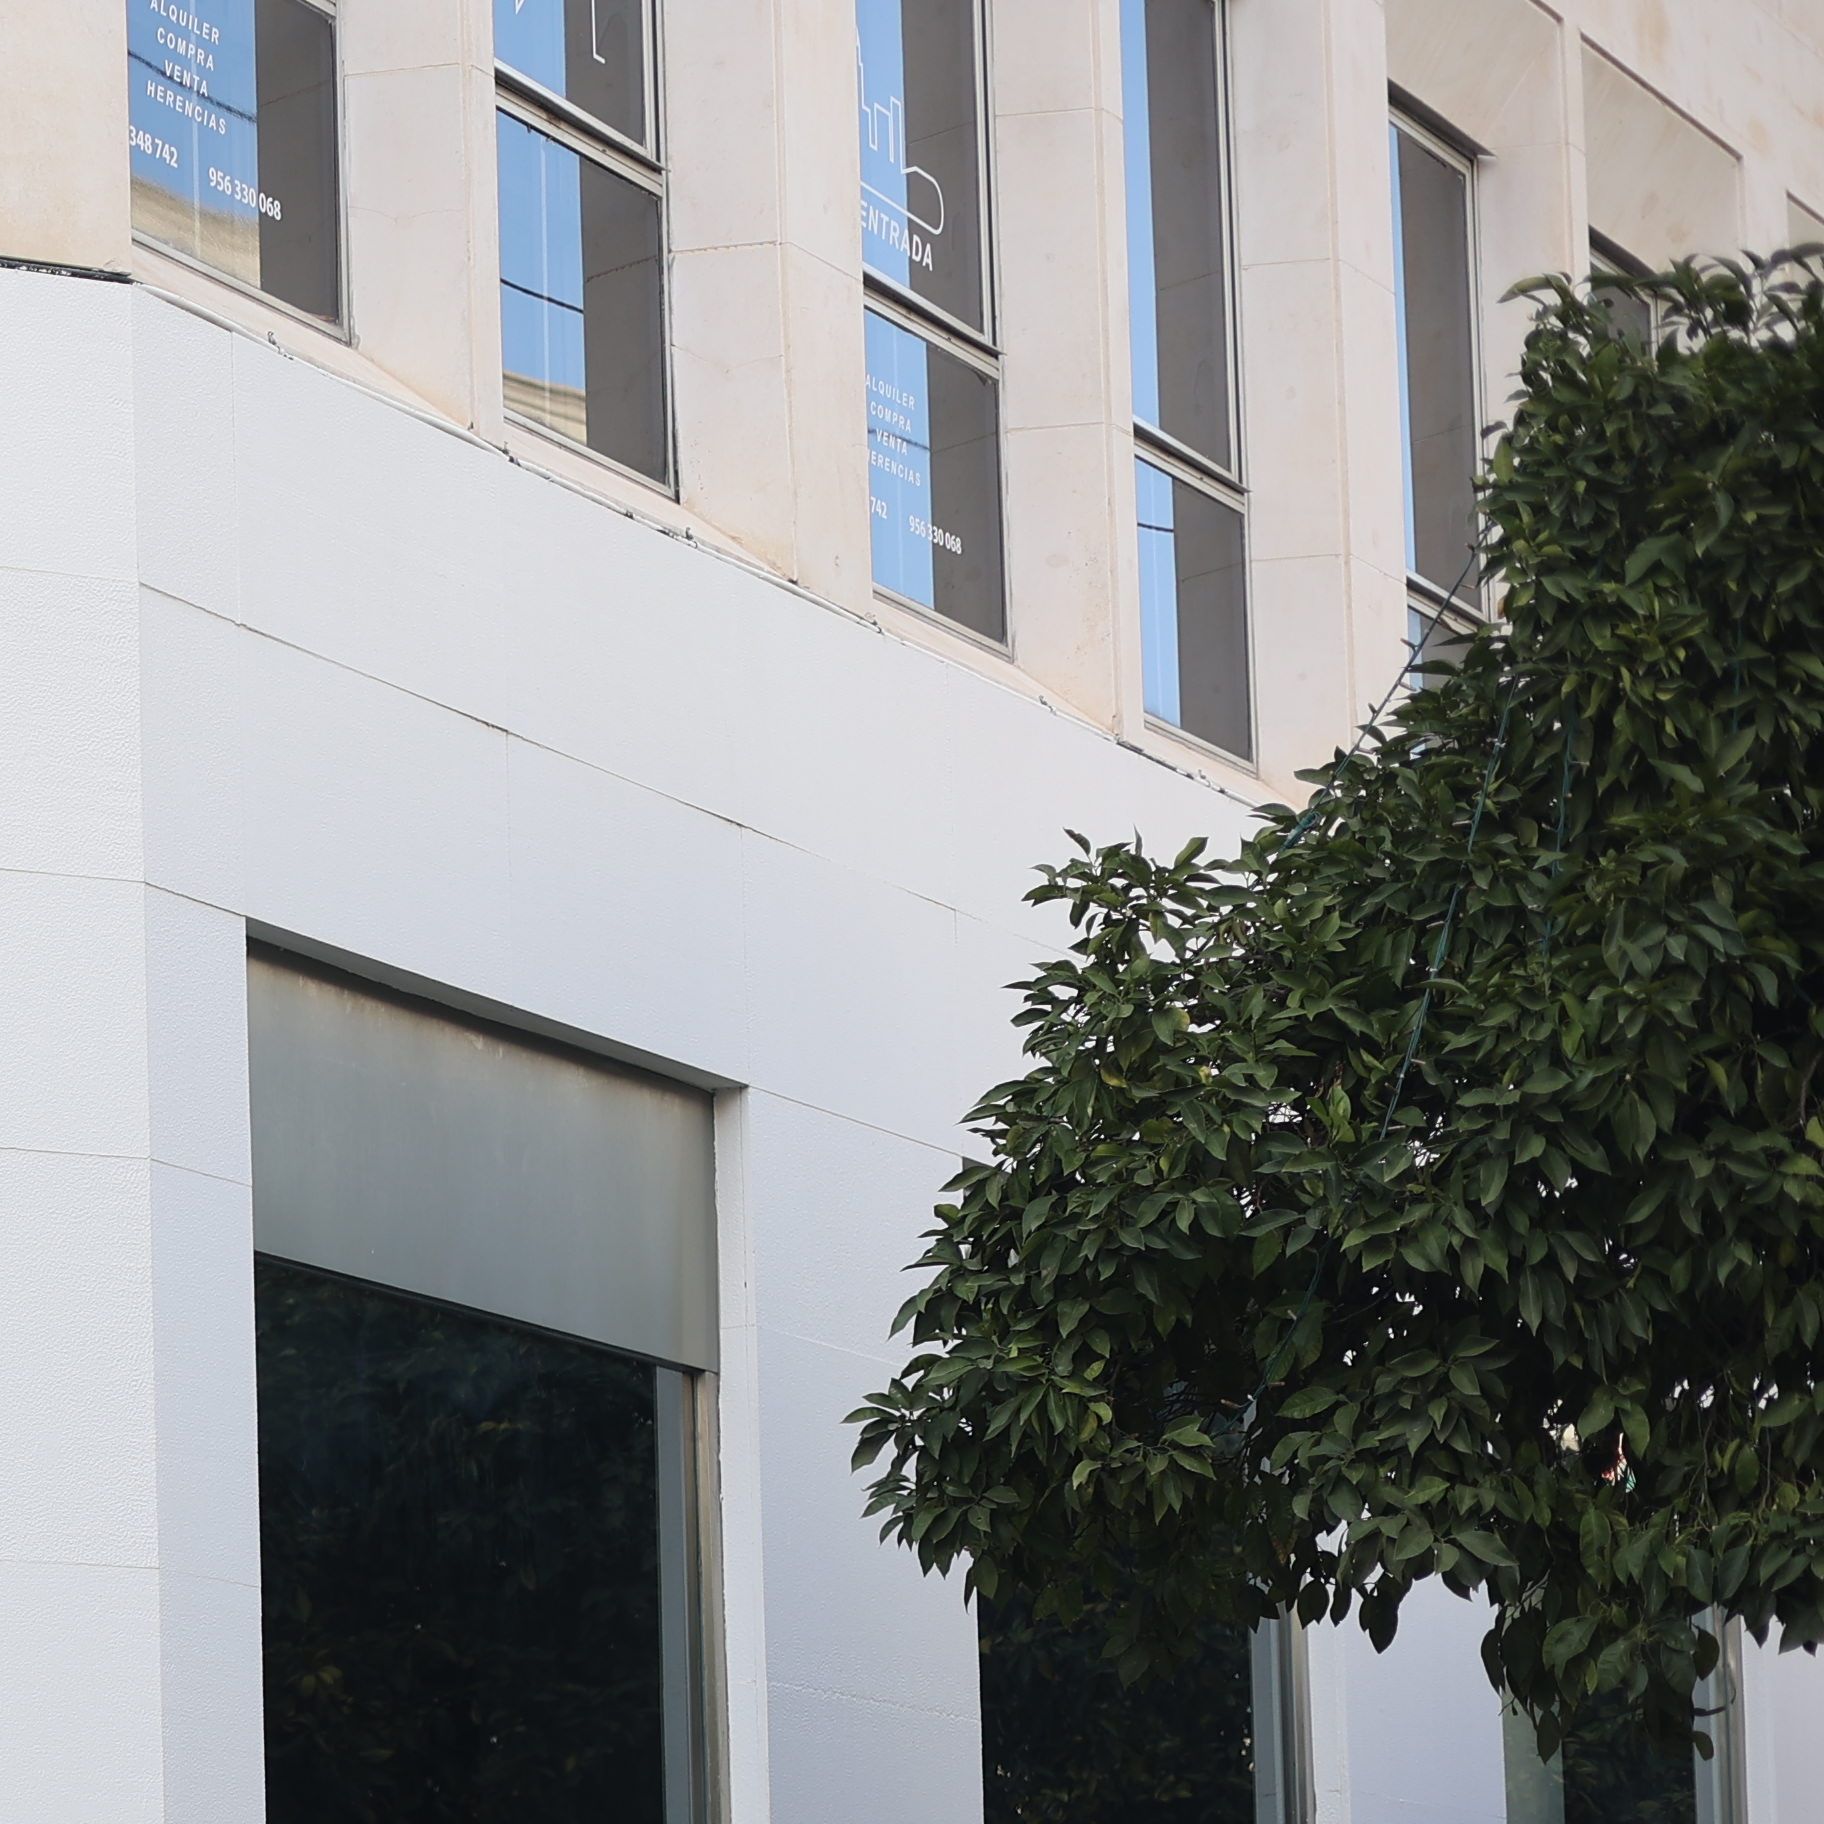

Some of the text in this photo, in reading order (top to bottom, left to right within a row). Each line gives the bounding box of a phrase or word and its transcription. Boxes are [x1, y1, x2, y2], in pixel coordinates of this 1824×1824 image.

[150, 0, 220, 45] ALQUILER
[157, 28, 214, 71] COMPRA
[165, 60, 208, 97] VENTA
[147, 80, 226, 135] HERENCIAS
[129, 126, 178, 168] 348 742
[208, 167, 282, 221] 956 330 068
[860, 200, 933, 272] ENTRADA
[866, 374, 915, 410] ALQUILER
[870, 401, 912, 433] COMPRA
[876, 428, 909, 456] VENTA
[870, 496, 888, 519] 742
[909, 515, 962, 555] 956 330 068
